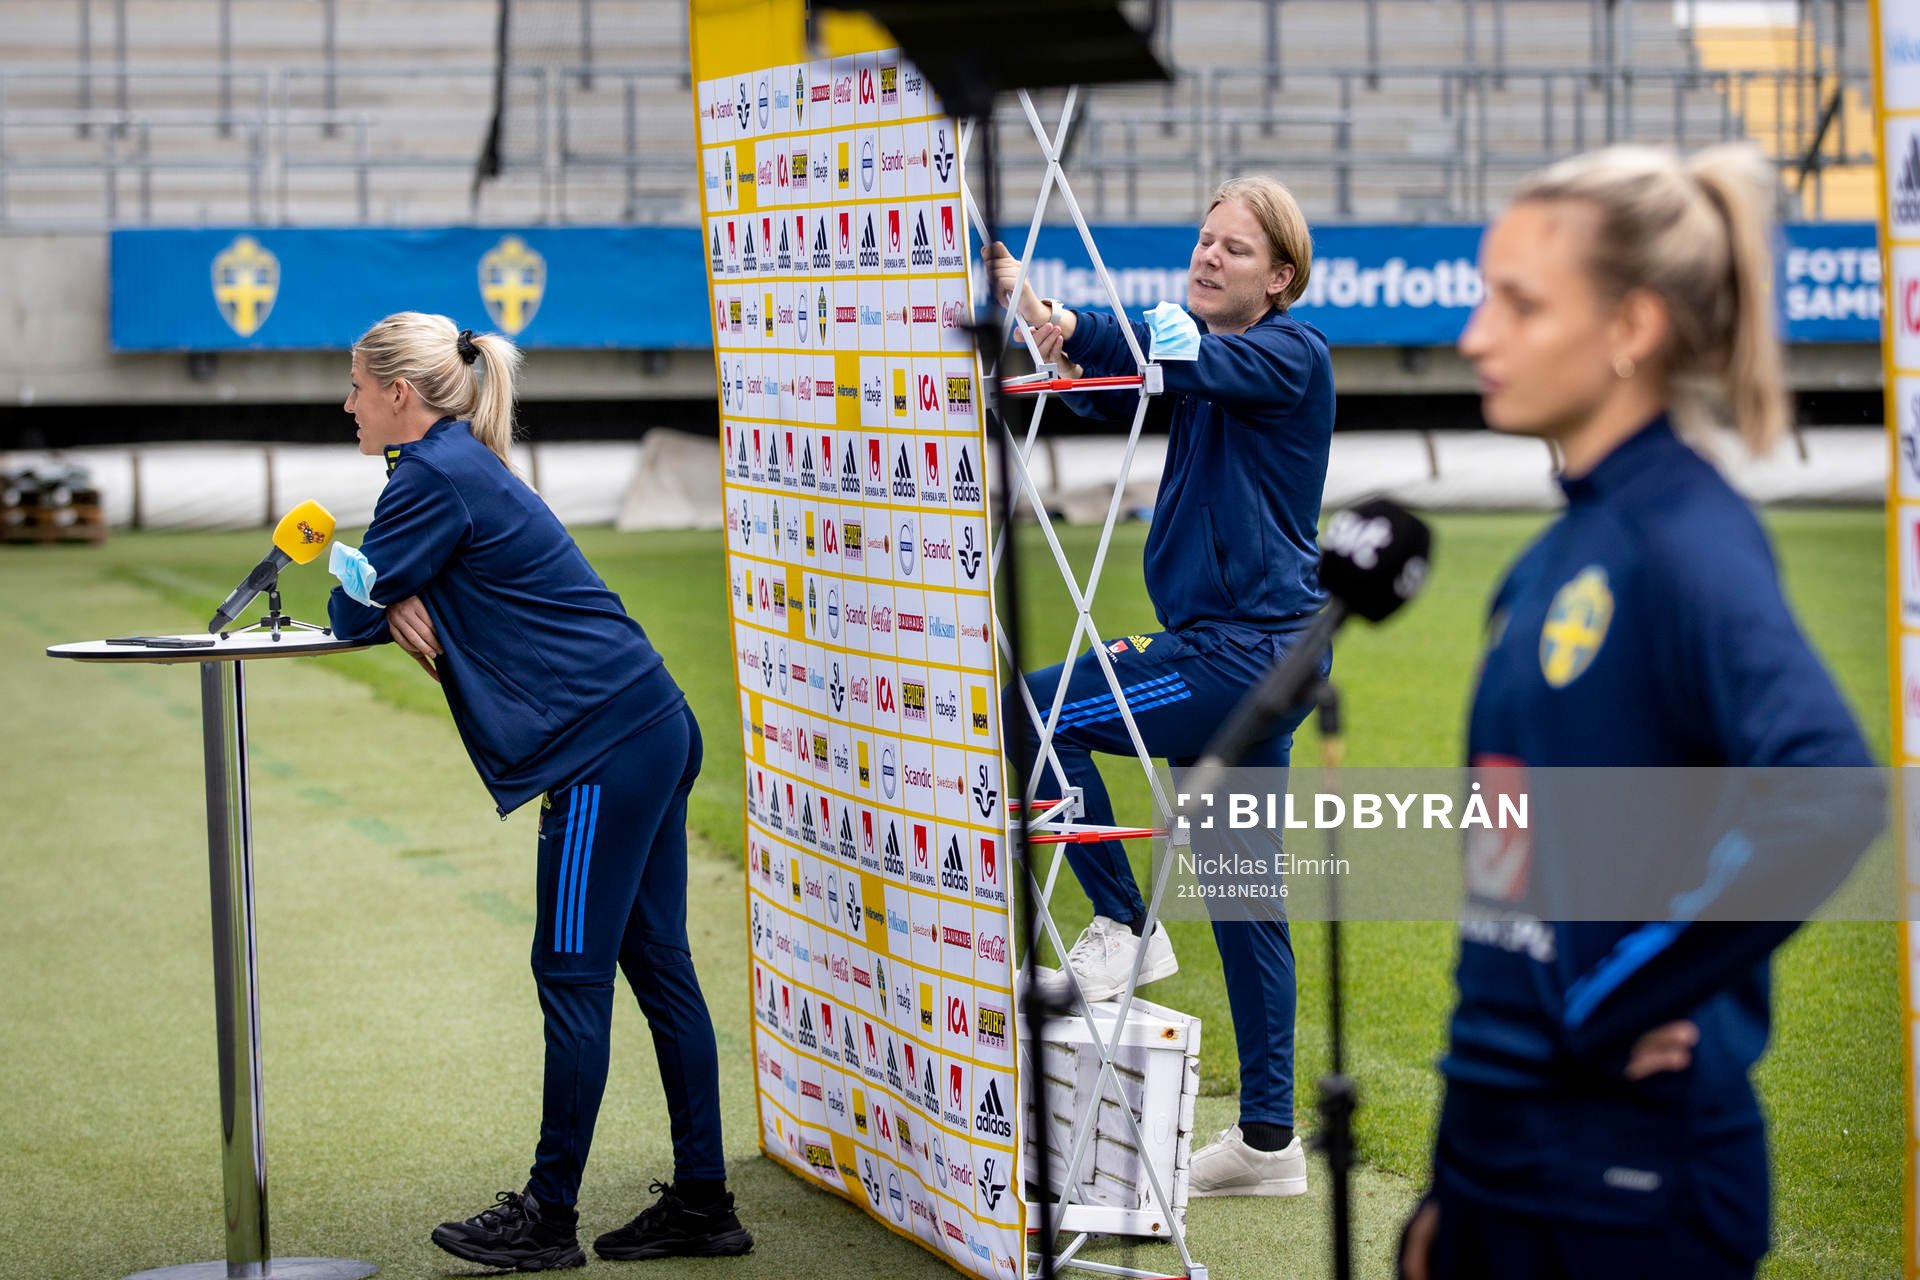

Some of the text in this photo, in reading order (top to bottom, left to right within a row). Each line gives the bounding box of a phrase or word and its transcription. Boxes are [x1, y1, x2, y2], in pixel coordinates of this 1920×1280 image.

[859, 69, 875, 104] ICA
[905, 73, 921, 96] Fabege
[717, 102, 733, 118] Scandic
[939, 129, 946, 153] SJ
[778, 154, 788, 187] ICA
[814, 162, 828, 182] Fabege
[882, 150, 903, 171] Scandic
[778, 253, 791, 269] adidas
[813, 250, 830, 268] adidas
[860, 249, 878, 267] adidas
[884, 259, 906, 268] SVENSKA SPEL
[912, 247, 932, 265] adidas
[938, 257, 963, 266] SVENSKA SPEL
[778, 306, 793, 325] Scandic
[836, 307, 856, 322] BAUHAUS
[912, 307, 936, 322] BAUHAUS
[865, 382, 881, 406] Fabege
[918, 374, 939, 411] ICA
[947, 378, 971, 403] SPORT
[949, 404, 971, 412] BLADET
[768, 464, 780, 482] adidas
[801, 469, 815, 488] adidas
[841, 474, 860, 492] adidas
[864, 486, 887, 497] SVENSKA SPEL
[893, 478, 915, 498] adidas
[921, 491, 947, 502] SVENSKA SPEL
[953, 481, 980, 501] adidas
[823, 520, 838, 554] ICA
[844, 523, 861, 550] SPORT
[965, 526, 973, 550] SJ
[923, 538, 951, 559] Scandic
[759, 577, 769, 610] ICA
[846, 603, 866, 625] Scandic
[871, 605, 891, 632] Coca-Cola
[898, 614, 923, 631] BAUHAUS
[929, 616, 955, 639] Folksam
[961, 625, 982, 638] Swedbank
[834, 662, 839, 683] SJ
[876, 676, 895, 713] ICA
[904, 682, 924, 709] SPORT
[905, 708, 925, 719] BLADET
[936, 697, 956, 721] Fabege
[797, 728, 810, 763] ICA
[904, 765, 931, 788] Scandic
[937, 776, 957, 790] Swedbank
[980, 764, 988, 788] SJ
[802, 823, 816, 844] adidas
[840, 837, 856, 860] adidas
[884, 853, 904, 876] adidas
[805, 876, 822, 900] Scandic
[909, 871, 935, 887] SVENSKA SPEL
[942, 868, 968, 891] adidas
[849, 881, 855, 905] SJ
[975, 886, 1005, 902] SVENSKA SPEL
[888, 909, 908, 936] Folksam
[943, 927, 971, 949] BAUHAUS
[978, 931, 1005, 963] Coca-Cola
[948, 996, 968, 1037] ICA
[979, 1006, 1005, 1039] SPORT
[799, 1022, 817, 1049] adidas
[979, 1035, 1005, 1047] BLADET
[845, 1045, 860, 1069] adidas
[923, 1090, 939, 1115] adidas
[873, 1103, 891, 1142] ICA
[944, 1110, 967, 1129] SVENSKA SPEL
[976, 1112, 1011, 1137] adidas
[948, 1157, 972, 1186] Scandic
[984, 1157, 994, 1181] SJ
